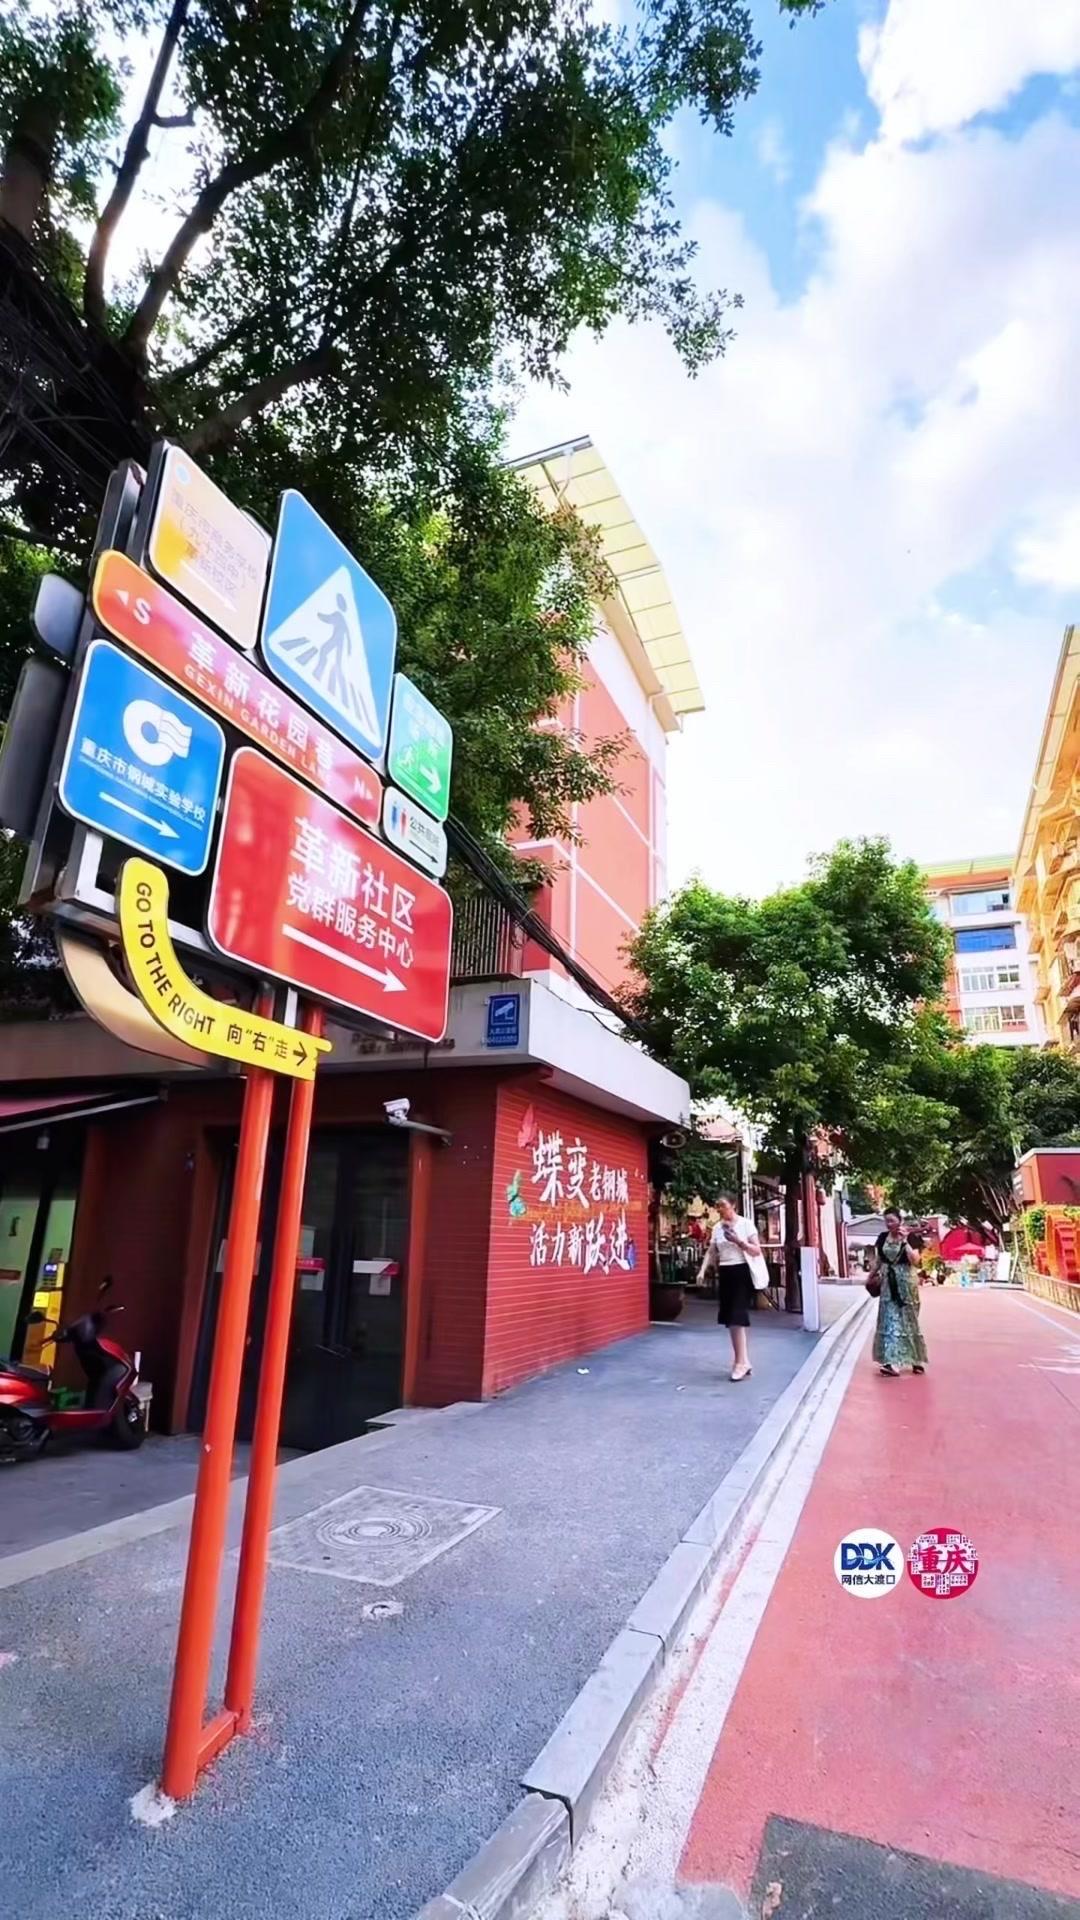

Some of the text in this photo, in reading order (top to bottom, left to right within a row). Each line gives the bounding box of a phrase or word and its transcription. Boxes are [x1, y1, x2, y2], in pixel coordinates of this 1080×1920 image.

[133, 598, 152, 625] S
[188, 631, 335, 772] 革新花园巷
[184, 664, 234, 709] GEXIN
[240, 708, 297, 758] GARDEN
[80, 737, 206, 823] 重庆市钢城实验学校
[136, 882, 152, 913] GO
[290, 815, 416, 935] 革新社区
[138, 920, 156, 949] TO
[286, 872, 414, 969] 党群服务中心
[146, 952, 172, 996] THE
[168, 993, 216, 1035] RIGHT
[531, 1129, 629, 1209] 蝶变老钢城
[530, 1207, 631, 1275] 活力新跃进
